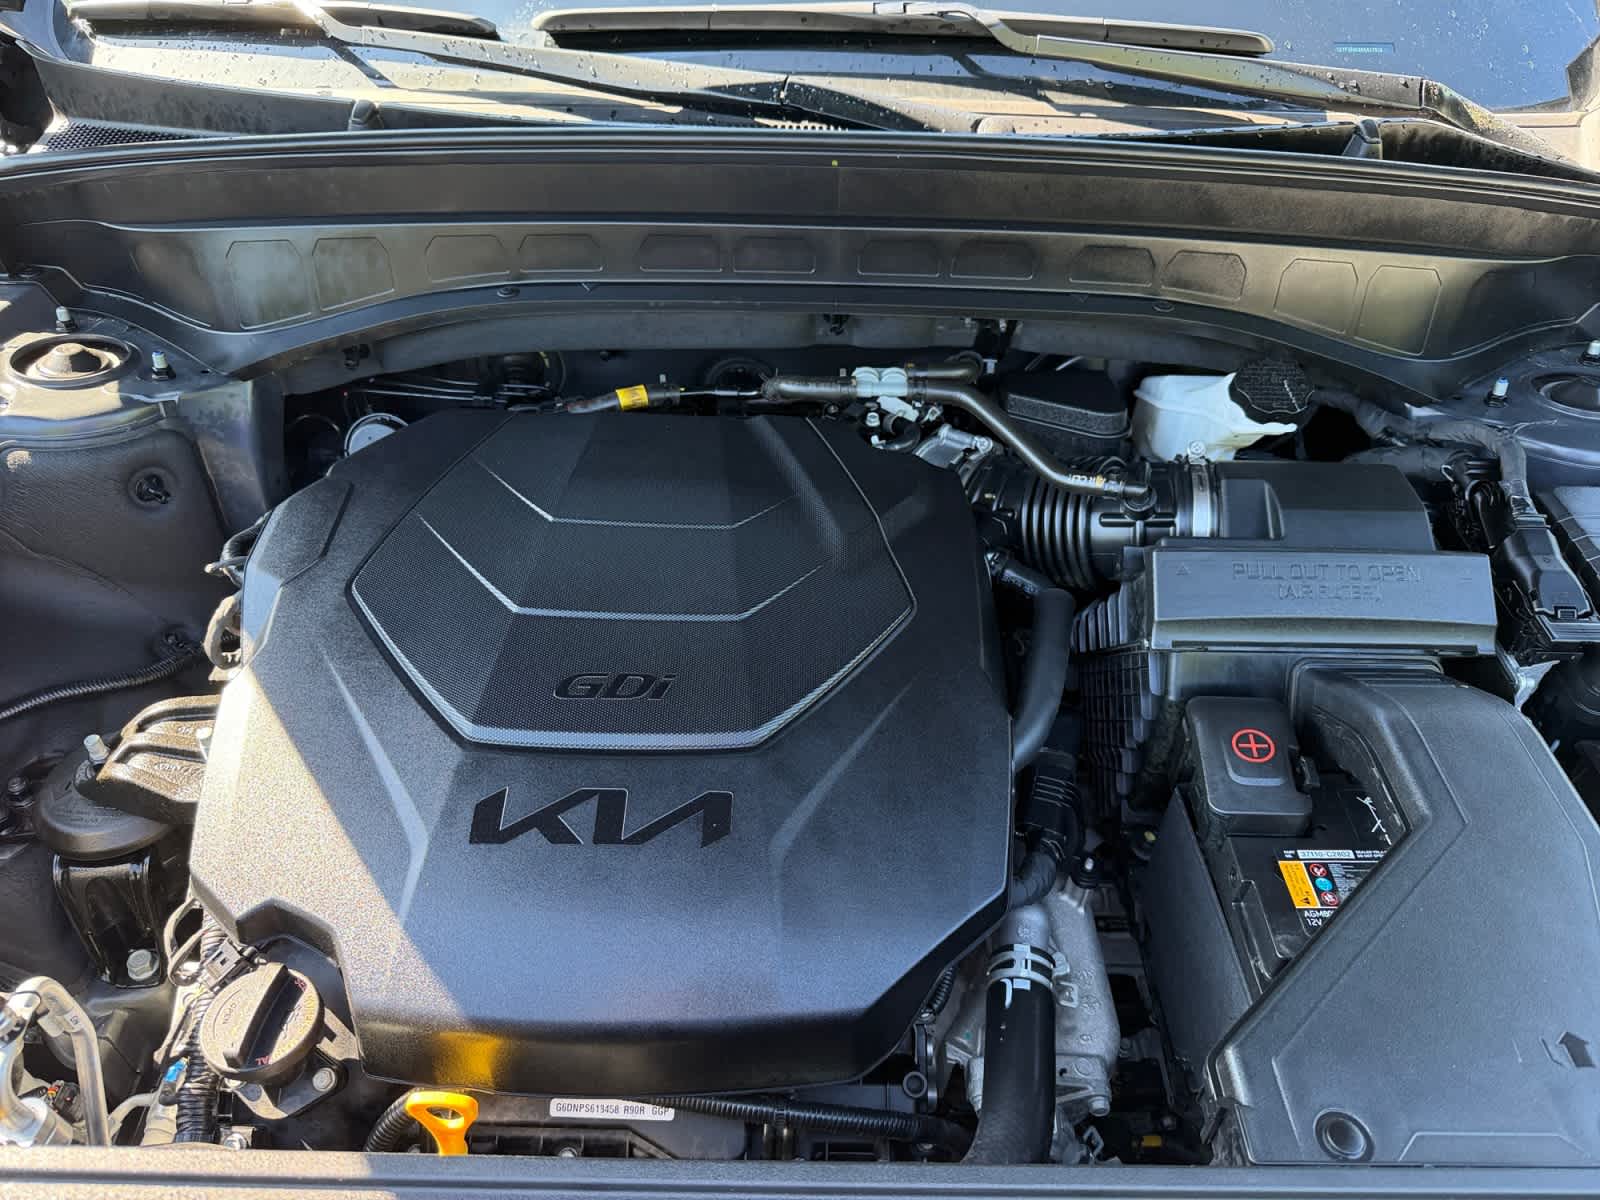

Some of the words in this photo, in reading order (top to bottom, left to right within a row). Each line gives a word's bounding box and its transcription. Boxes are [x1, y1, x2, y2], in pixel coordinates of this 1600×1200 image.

[1231, 562, 1285, 581] PULL
[1289, 563, 1329, 581] OUT
[1335, 563, 1361, 582] TO
[1367, 564, 1422, 583] OPEN
[553, 673, 676, 701] GDi
[469, 786, 733, 849] KIA
[1307, 918, 1322, 926] 12V
